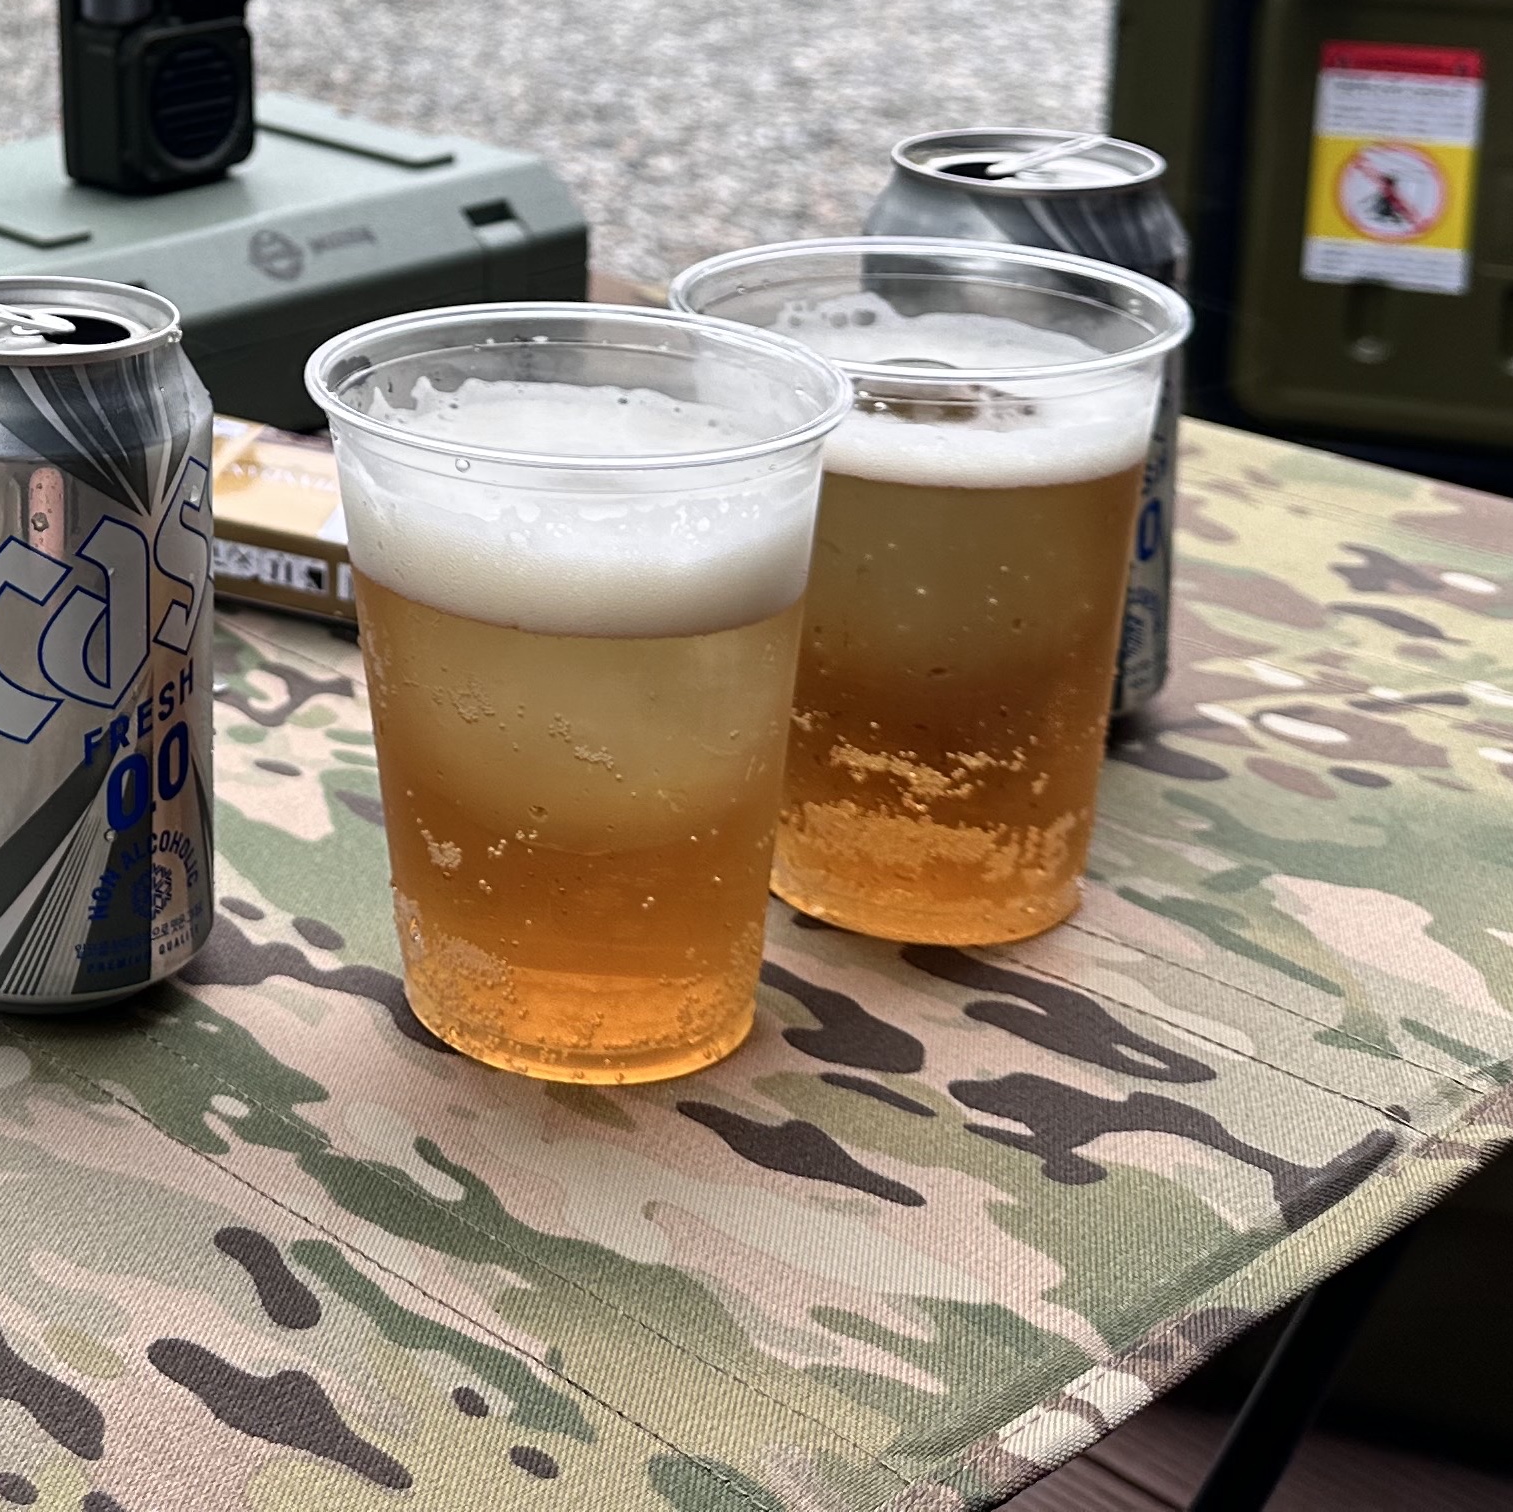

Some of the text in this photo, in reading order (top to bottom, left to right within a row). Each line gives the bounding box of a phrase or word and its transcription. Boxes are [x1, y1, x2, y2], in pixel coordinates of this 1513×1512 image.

[83, 656, 195, 768] FRESH
[105, 719, 190, 833] 0.0
[88, 828, 201, 922] NON ALCOHOLIC
